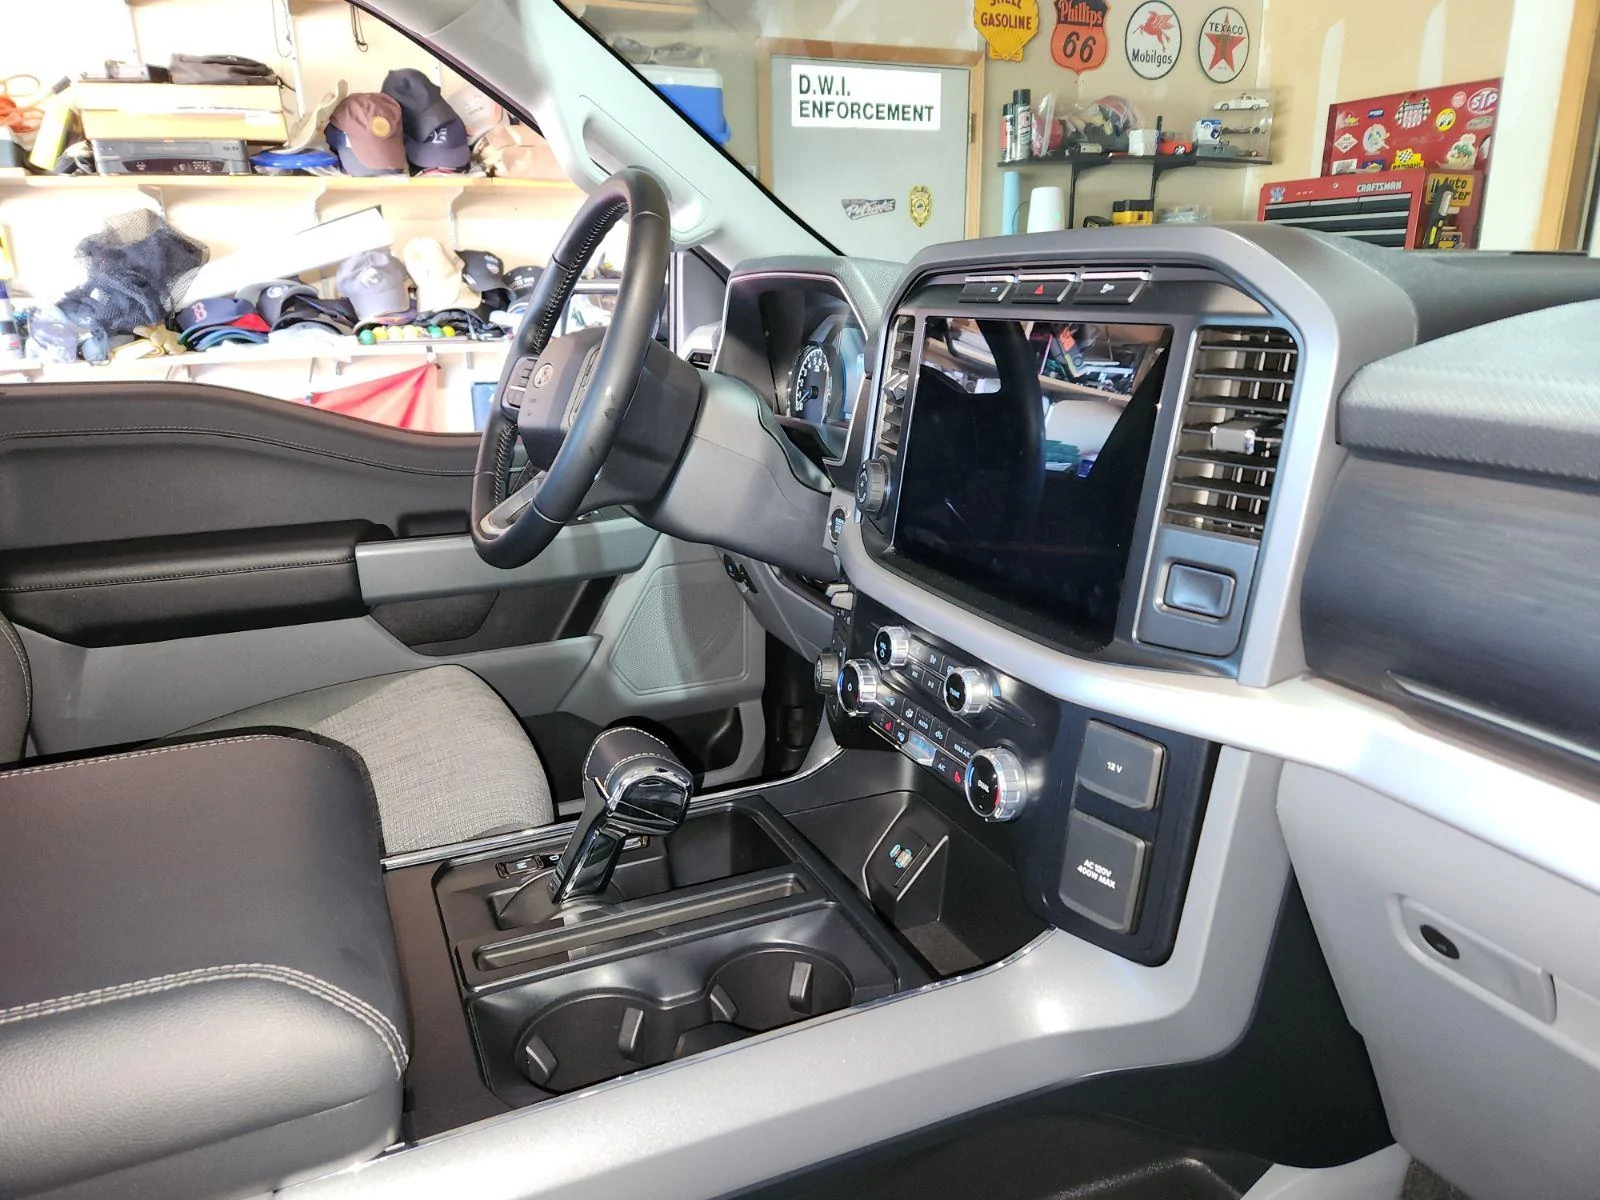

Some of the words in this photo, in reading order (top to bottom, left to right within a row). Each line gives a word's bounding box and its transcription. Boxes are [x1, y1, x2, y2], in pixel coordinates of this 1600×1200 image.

[990, 0, 1022, 10] SLL
[981, 12, 1032, 30] GASOLINE
[1058, 0, 1103, 29] Phillips
[1209, 22, 1243, 35] TEXACO
[1063, 31, 1096, 63] 66
[1131, 48, 1173, 68] Mobilgas
[799, 73, 851, 96] D.W.I.
[1471, 90, 1497, 111] STP
[799, 100, 934, 122] ENFORCEMENT
[1357, 181, 1402, 192] CRAFTSMAN
[917, 719, 929, 730] AUTO
[1106, 761, 1116, 771] 12
[1116, 764, 1123, 773] V
[977, 779, 990, 793] DUAL
[1083, 859, 1095, 870] AC
[1077, 865, 1098, 881] 400W
[1098, 874, 1116, 890] MAX
